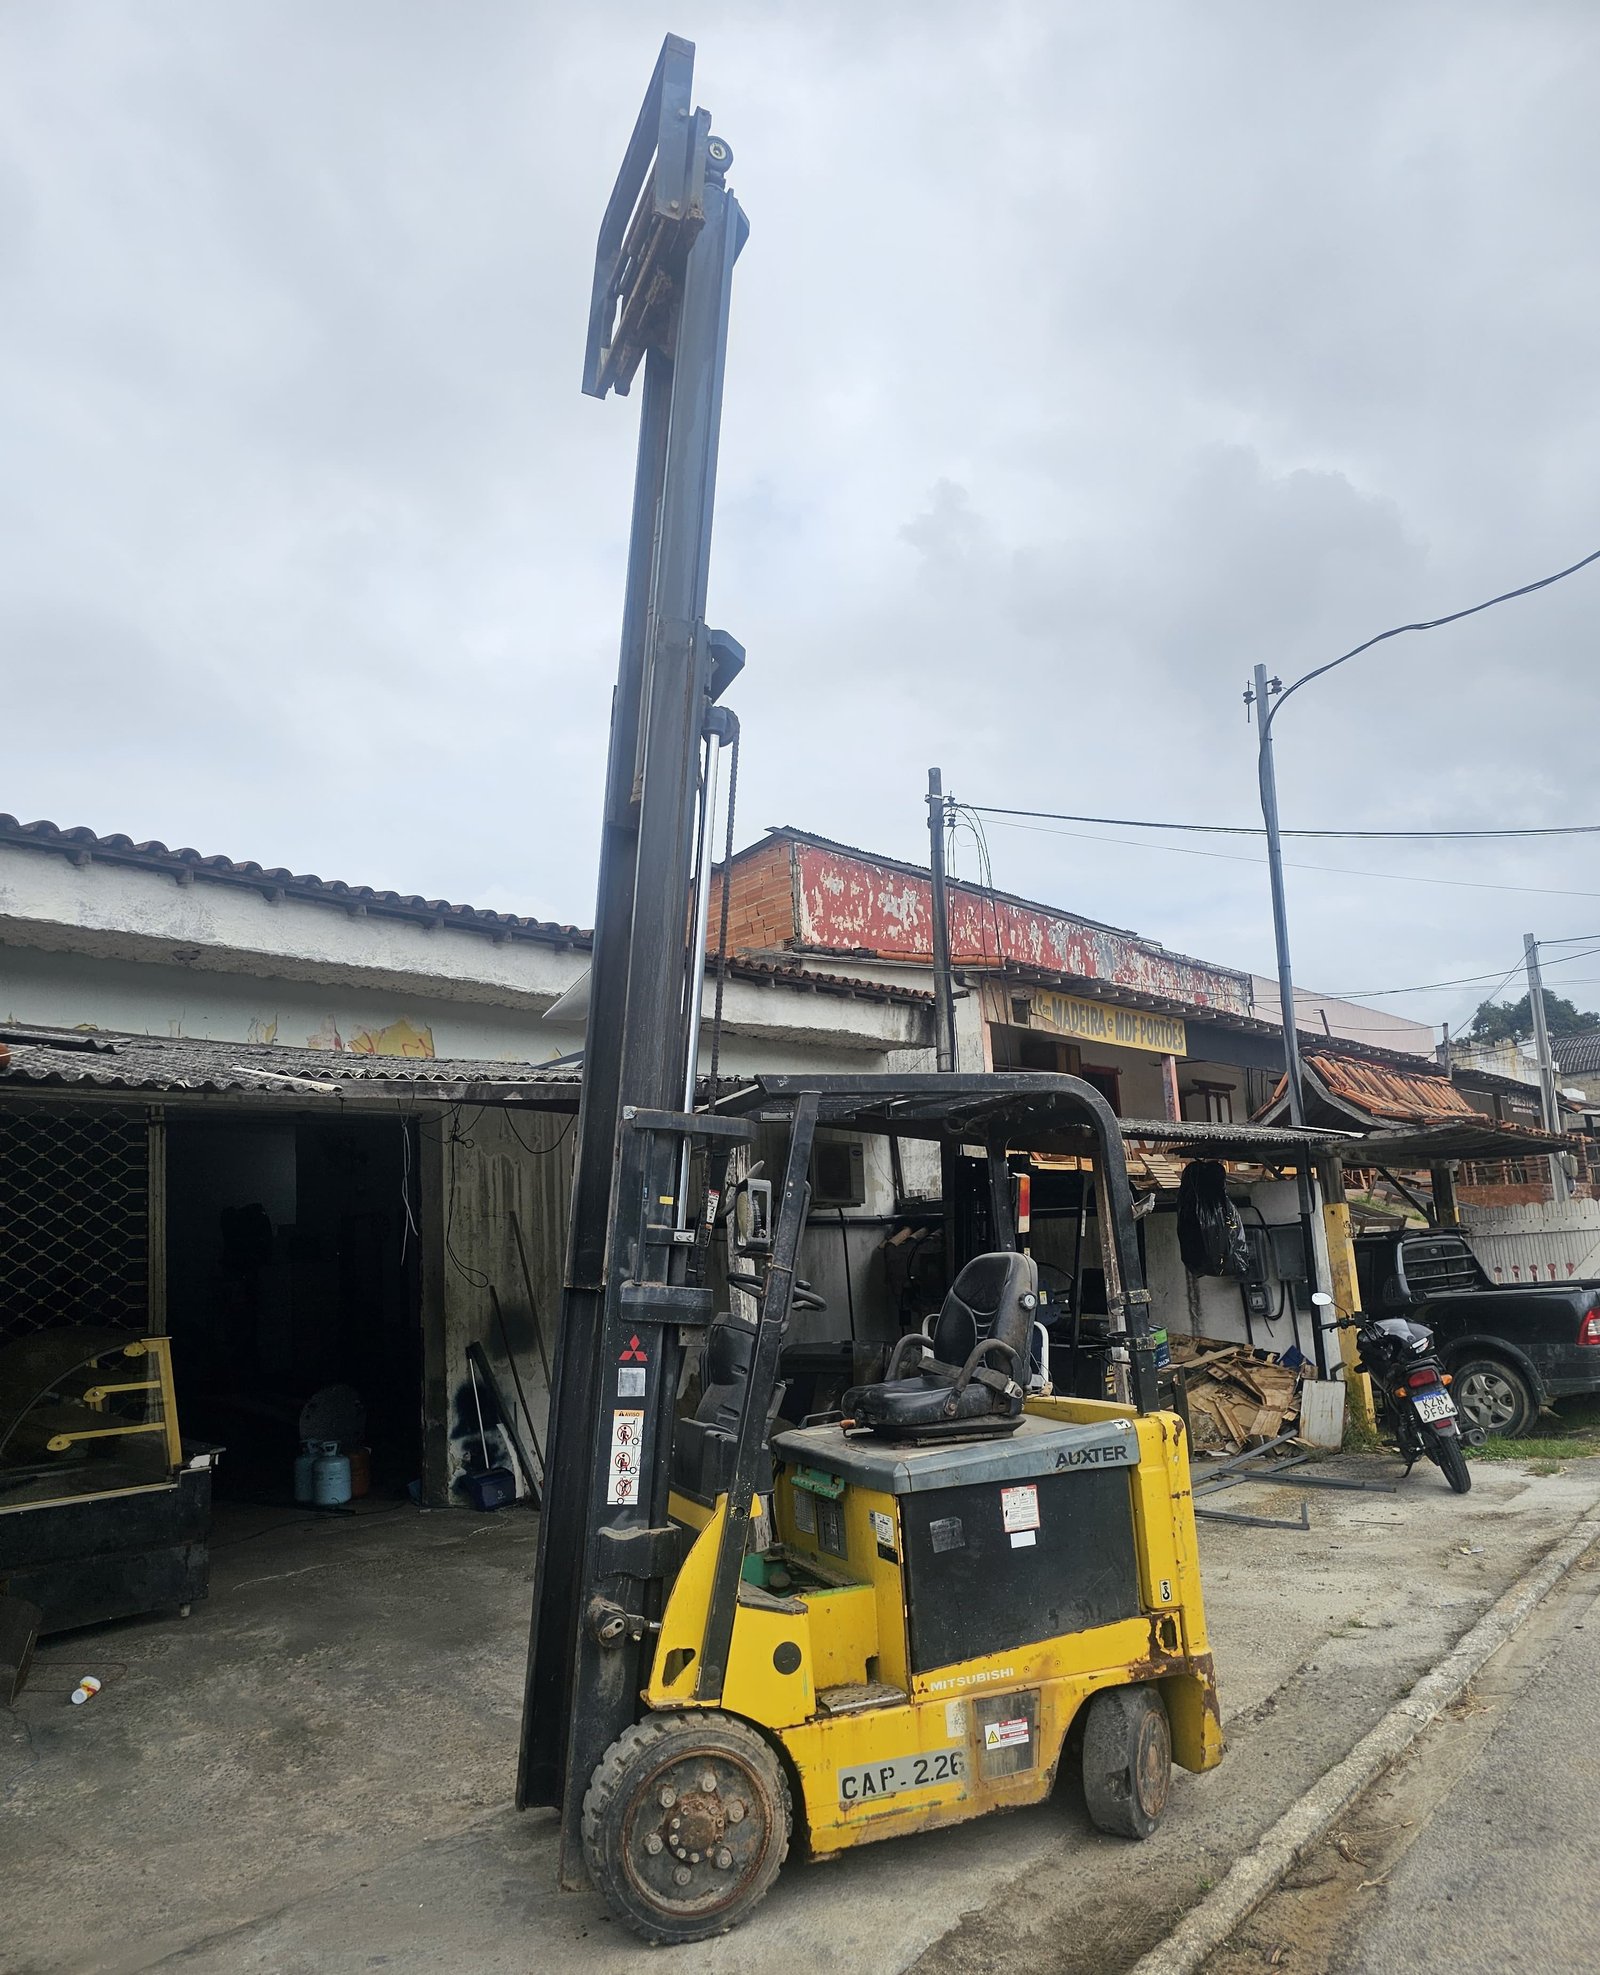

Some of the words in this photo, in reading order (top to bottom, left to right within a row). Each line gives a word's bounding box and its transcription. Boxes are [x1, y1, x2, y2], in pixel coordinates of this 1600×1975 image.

[1051, 996, 1107, 1037] MADEIRA
[1107, 1018, 1113, 1032] e
[1140, 1016, 1184, 1050] PORTÕES
[1424, 1404, 1450, 1419] 9F86
[1055, 1445, 1128, 1468] AUXTER
[930, 1667, 1014, 1691] MITSUBISHI
